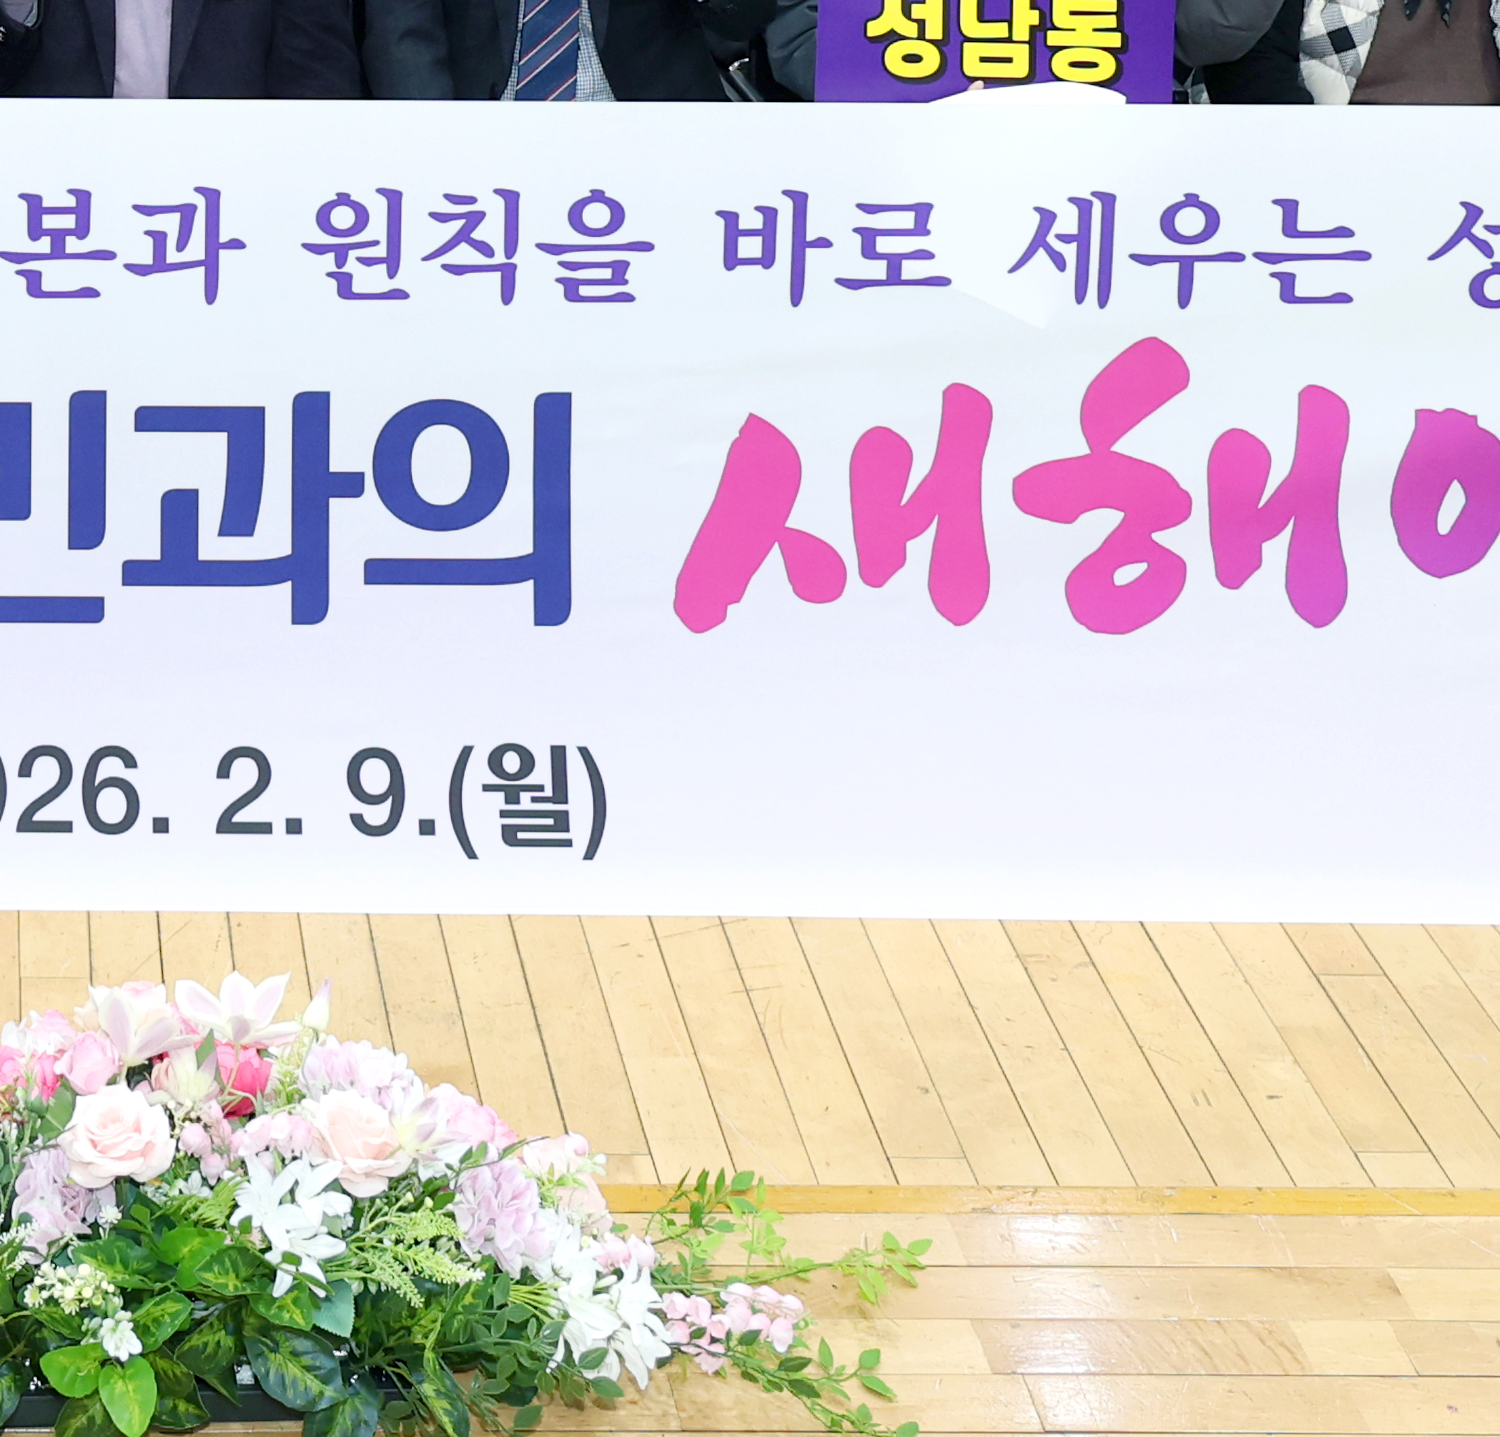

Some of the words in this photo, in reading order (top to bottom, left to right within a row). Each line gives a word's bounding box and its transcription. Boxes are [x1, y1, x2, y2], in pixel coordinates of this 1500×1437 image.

[301, 188, 655, 306] 원칙을
[715, 190, 951, 307] 바로
[1008, 191, 1372, 309] 세우는
[216, 746, 302, 835] 2.
[347, 743, 606, 860] 9.(월)
